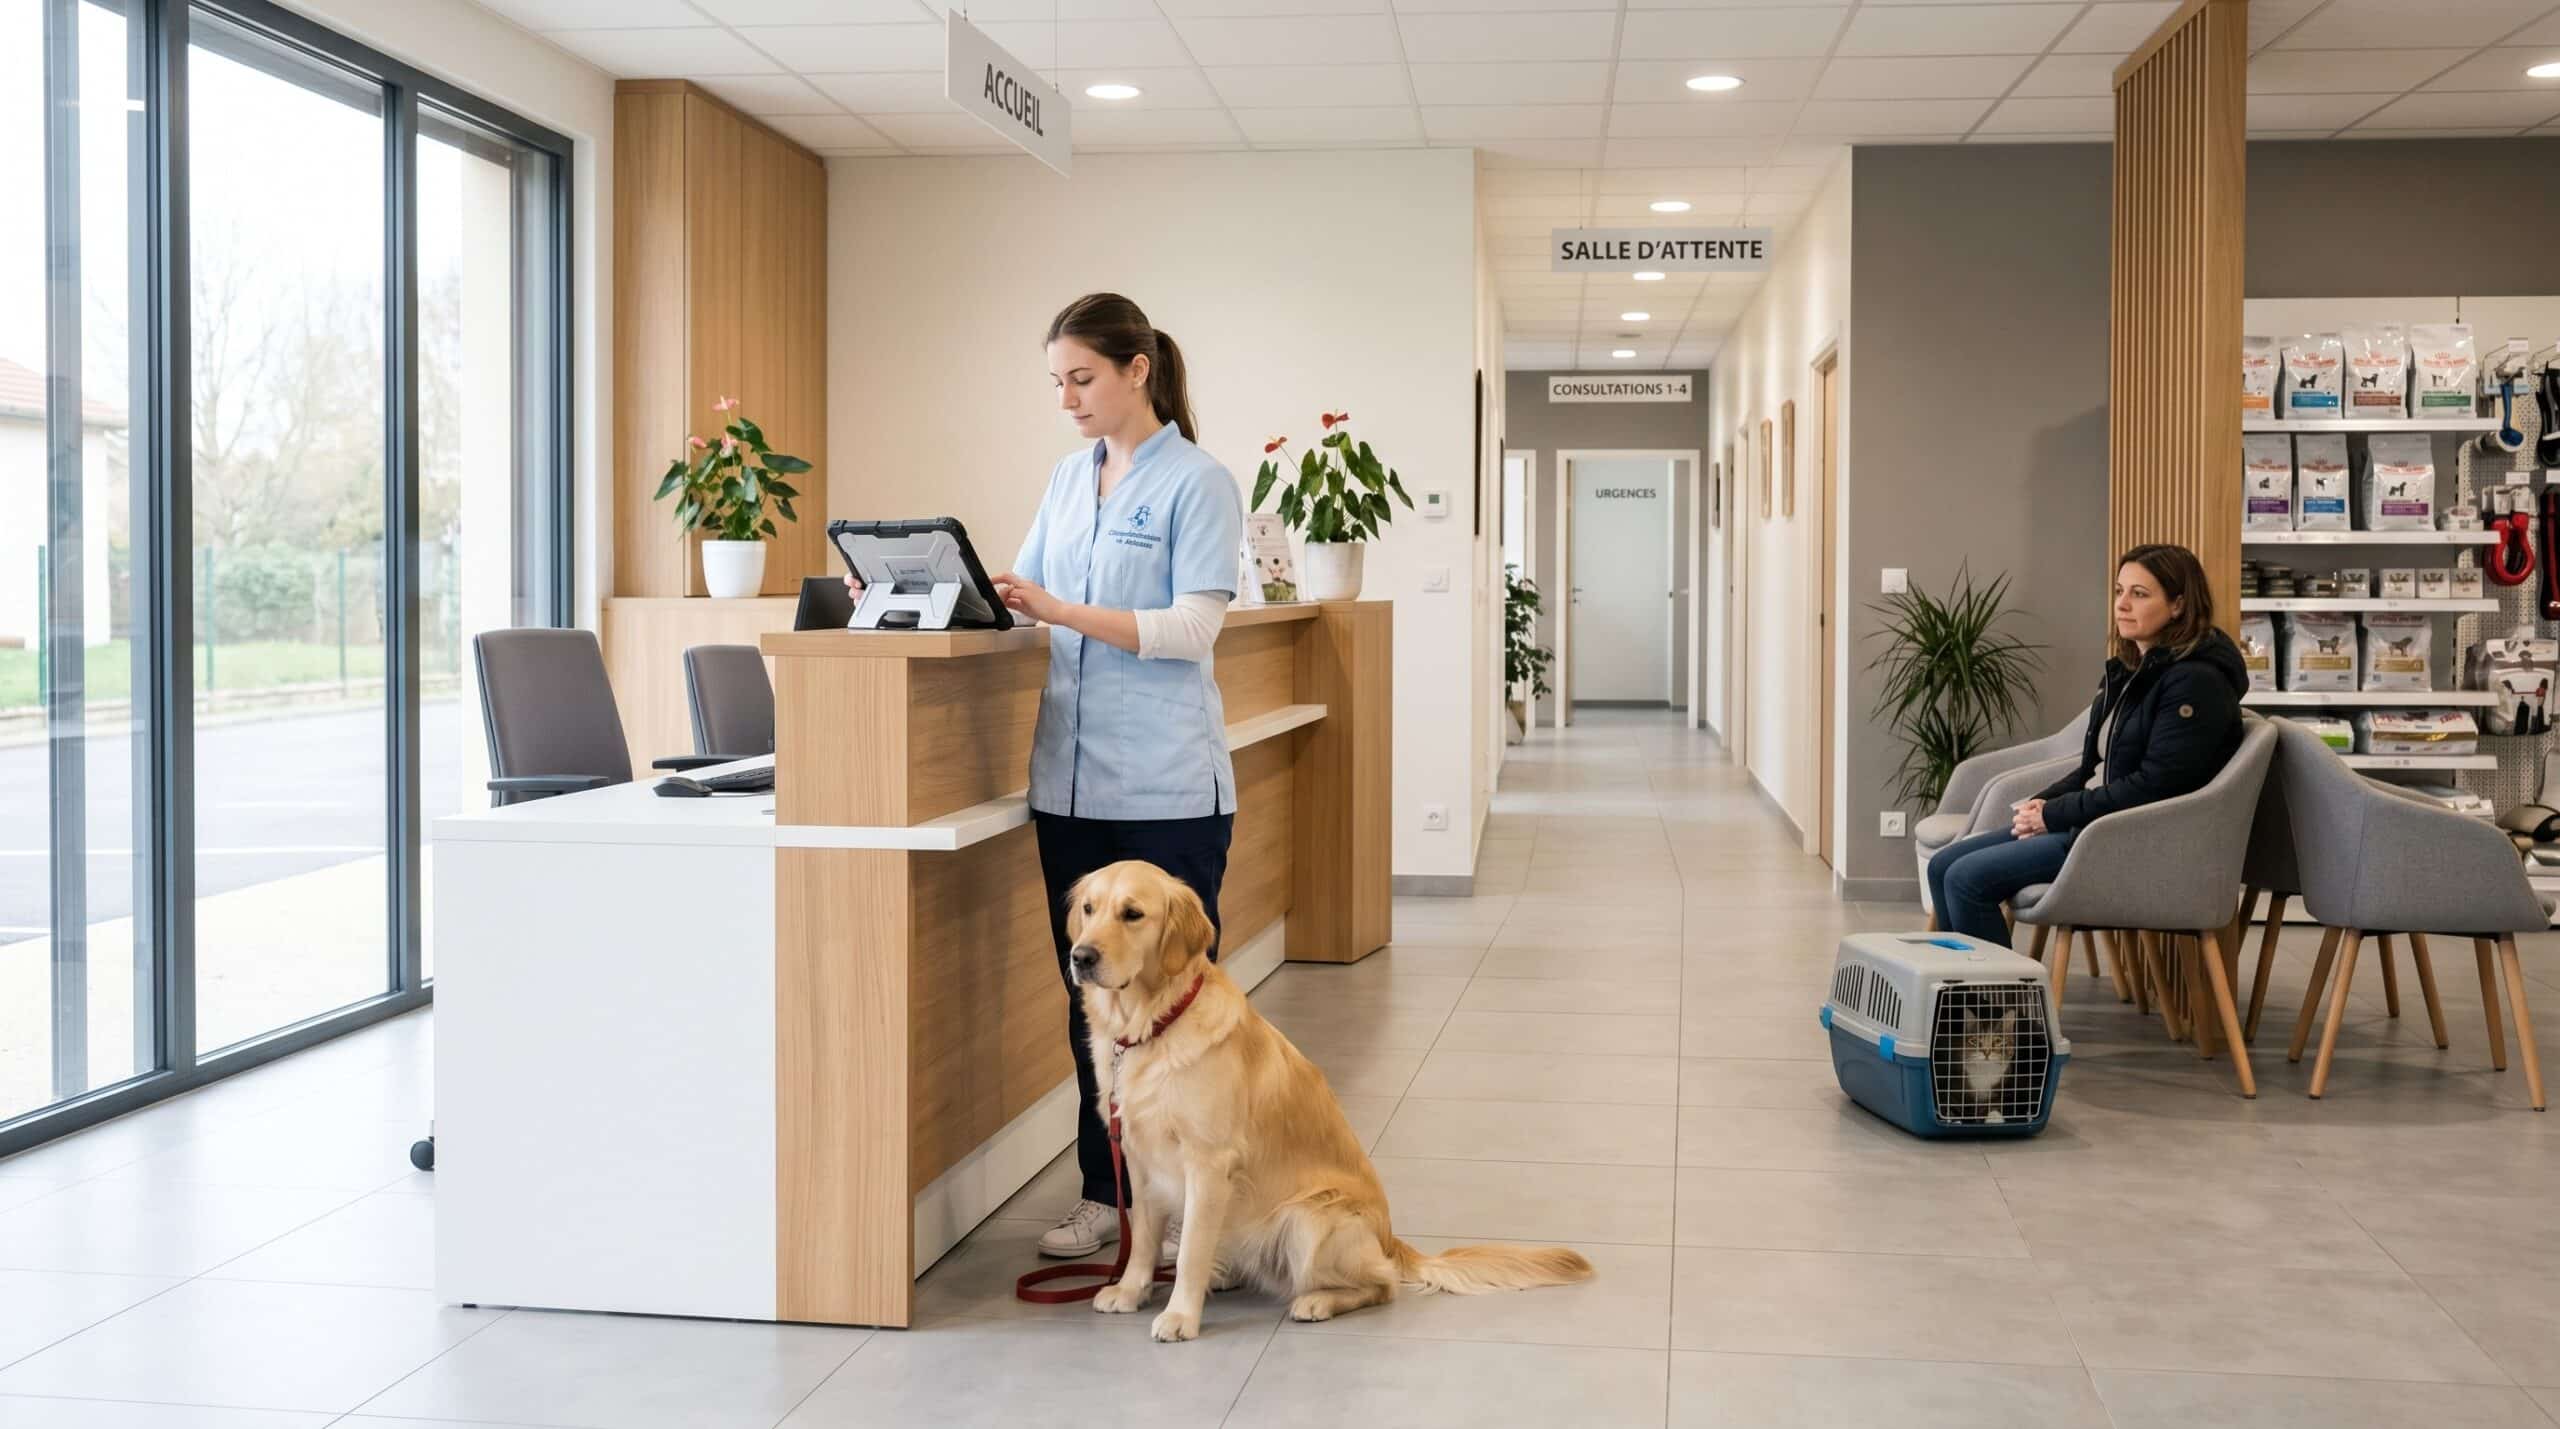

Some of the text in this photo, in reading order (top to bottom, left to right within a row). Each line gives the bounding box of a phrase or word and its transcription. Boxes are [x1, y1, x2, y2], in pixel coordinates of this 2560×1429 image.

[984, 62, 1044, 137] ACCUEIL
[1561, 240, 1763, 260] SALLE D'ATTENTE
[1553, 383, 1687, 396] CONSULTATIONS 1-4
[1595, 488, 1657, 498] URGENCES
